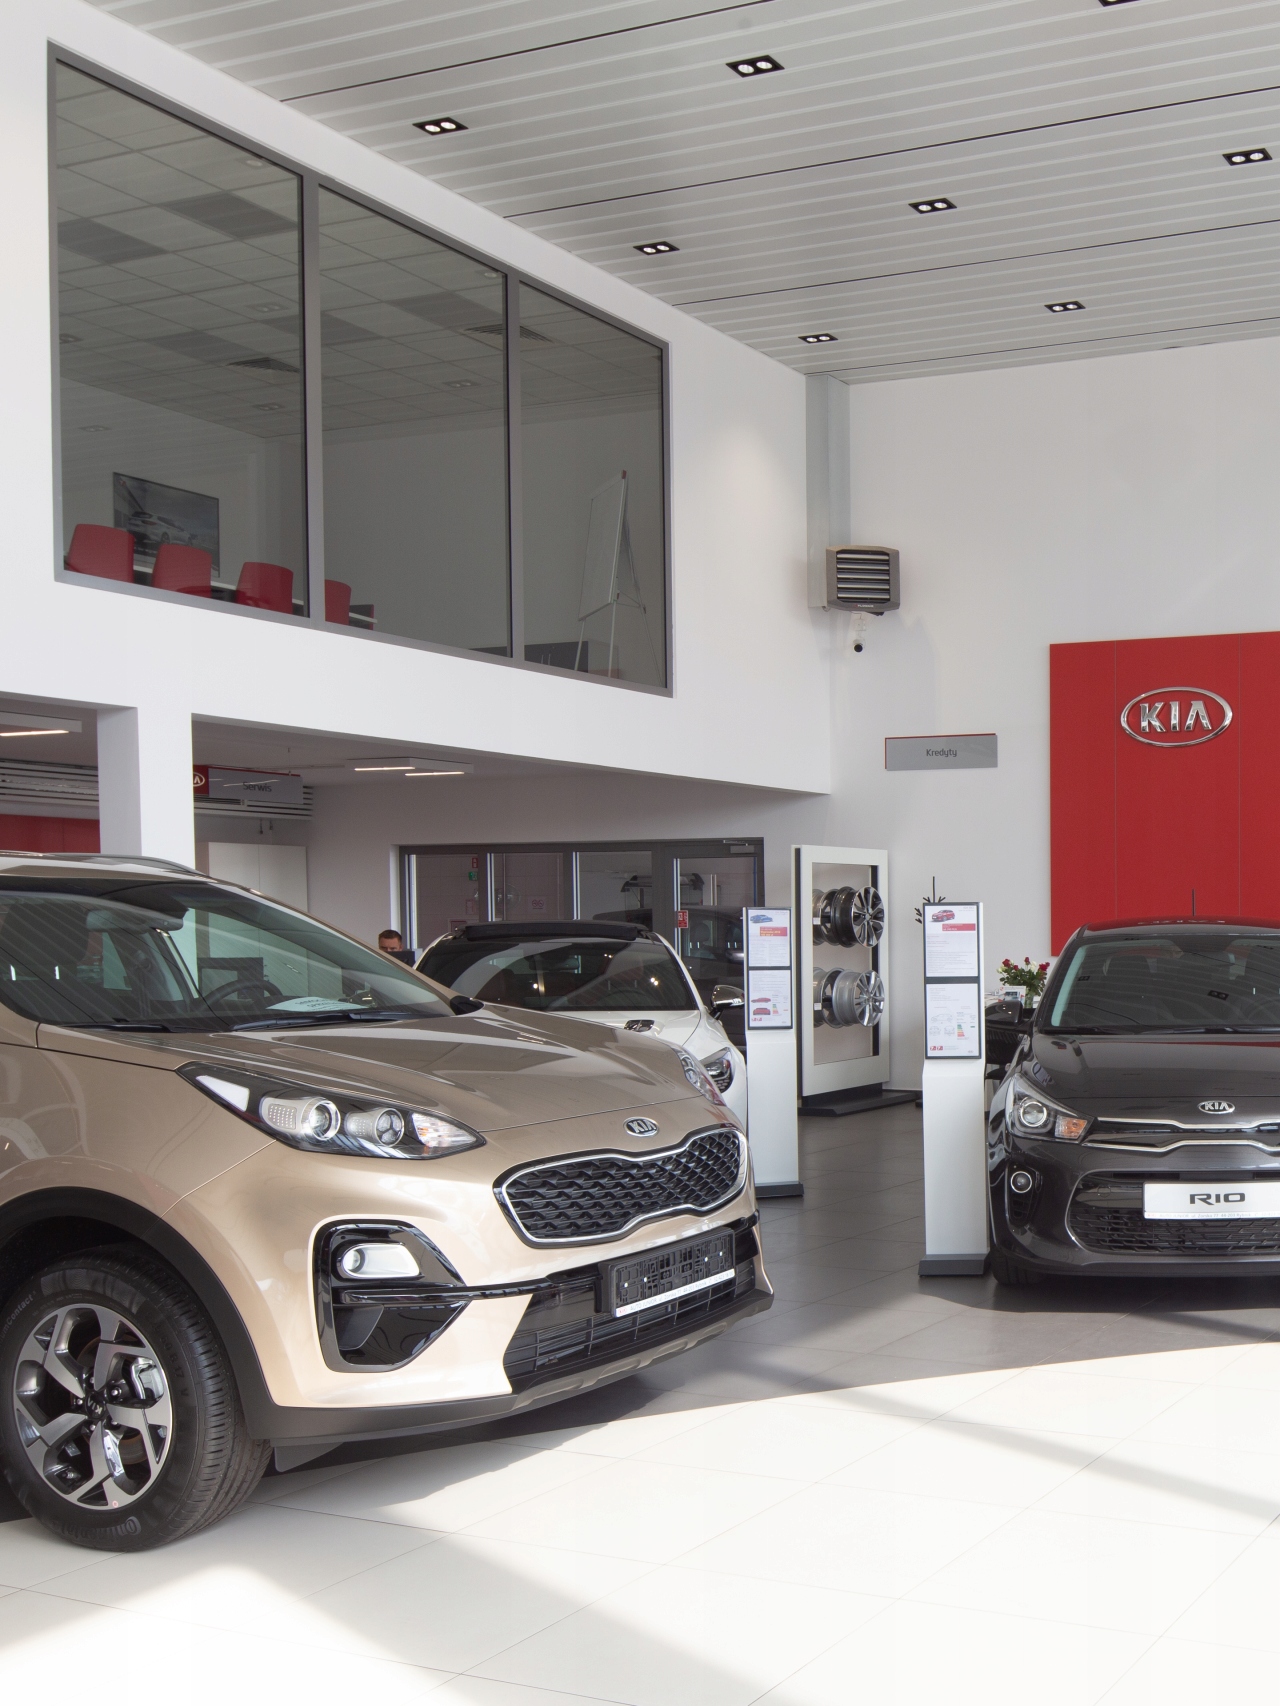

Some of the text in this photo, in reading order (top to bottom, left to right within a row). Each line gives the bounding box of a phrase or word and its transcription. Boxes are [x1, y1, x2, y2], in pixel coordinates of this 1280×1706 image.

[1139, 700, 1212, 733] KIA
[926, 748, 957, 757] Kredyty
[242, 781, 272, 792] Serwis
[1204, 1102, 1230, 1111] KIA
[628, 1119, 657, 1133] KIA
[1189, 1192, 1246, 1206] RIO
[87, 1397, 103, 1415] KIA
